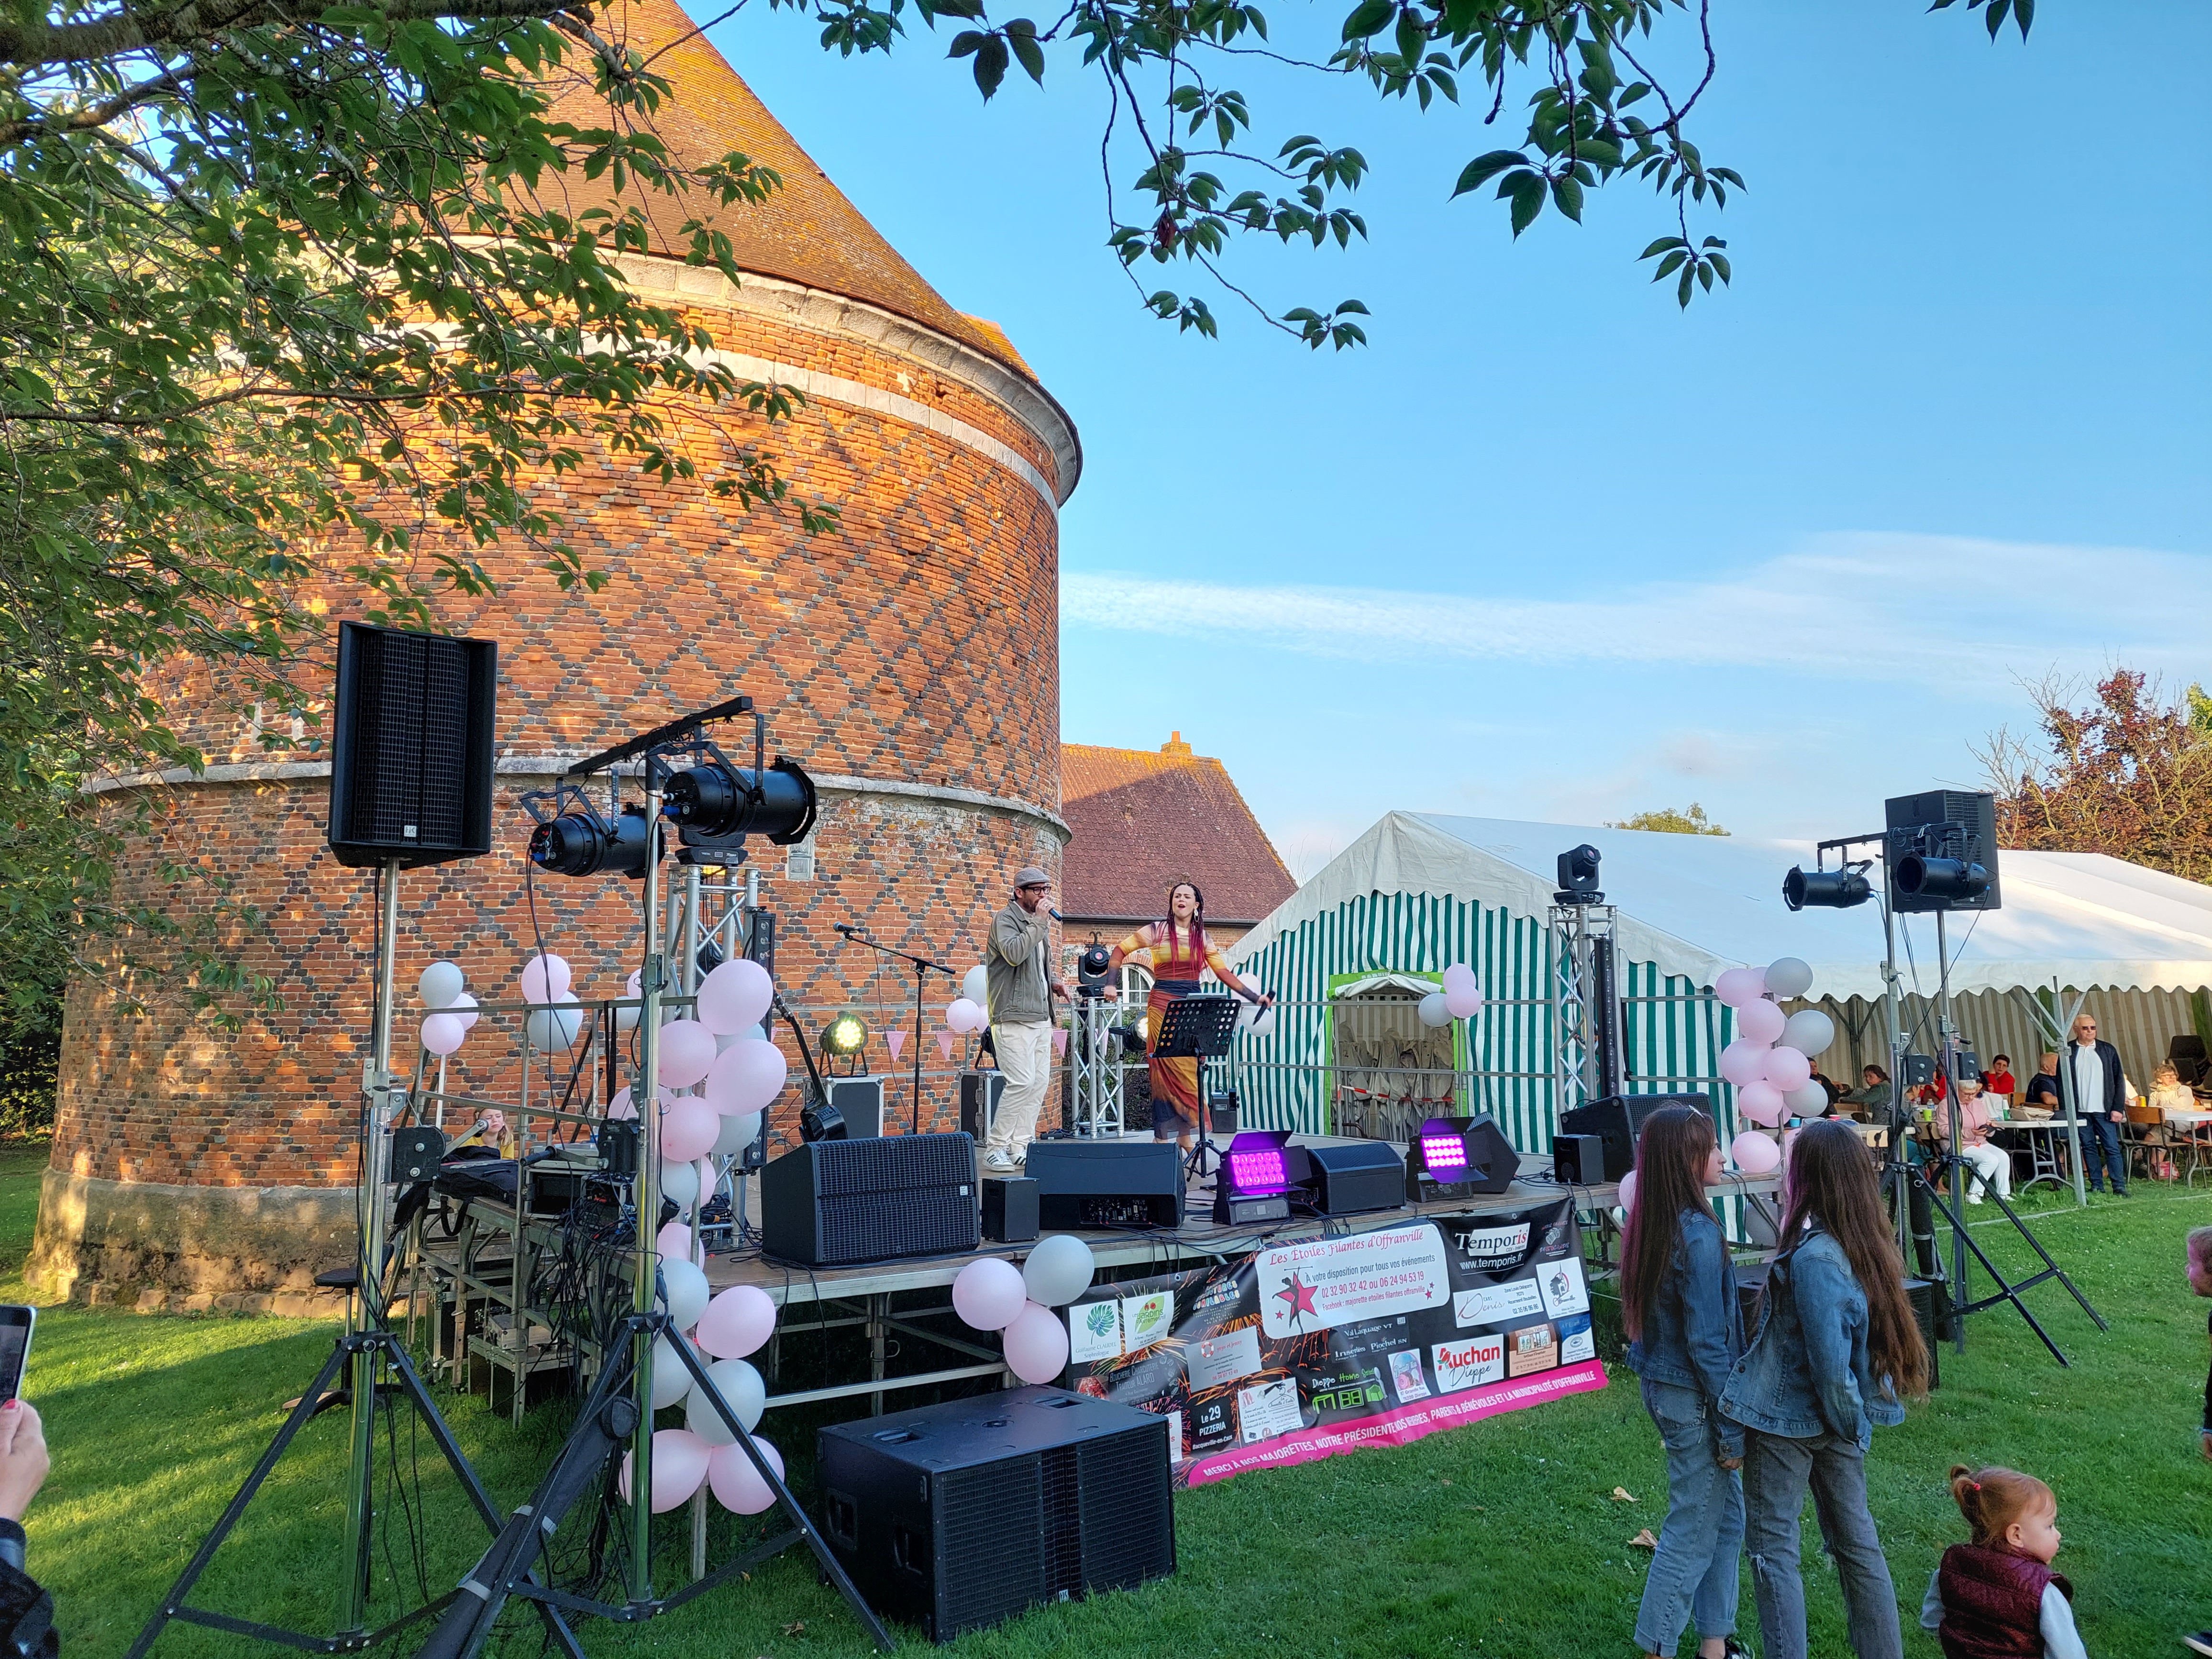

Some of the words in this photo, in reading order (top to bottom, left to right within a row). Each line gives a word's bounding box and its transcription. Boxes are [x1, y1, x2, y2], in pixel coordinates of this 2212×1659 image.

[1270, 1254, 1287, 1265] Les
[1292, 1247, 1325, 1261] Étoiles
[1328, 1239, 1365, 1257] Filantes
[1368, 1228, 1424, 1250] d'Offranville
[1455, 1229, 1528, 1254] Temporis
[1305, 1272, 1311, 1283] À
[1312, 1272, 1326, 1282] votre
[1327, 1266, 1359, 1280] disposition
[1360, 1264, 1374, 1274] pour
[1375, 1261, 1389, 1271] tous
[1390, 1259, 1401, 1268] vos
[1401, 1254, 1436, 1267] événements
[1459, 1252, 1524, 1270] www.temporis.fr
[1322, 1287, 1328, 1298] 02
[1330, 1286, 1338, 1296] 32
[1339, 1283, 1347, 1294] 90
[1349, 1282, 1357, 1293] 32
[1359, 1280, 1368, 1291] 42
[1369, 1281, 1378, 1289] ou
[1380, 1277, 1388, 1287] 06
[1390, 1275, 1398, 1286] 24
[1399, 1273, 1407, 1284] 94
[1409, 1272, 1416, 1283] 53
[1417, 1271, 1424, 1281] 19
[1345, 1295, 1368, 1306] majorette
[1369, 1292, 1384, 1302] etoiles
[1385, 1289, 1403, 1299] filantes
[1404, 1285, 1425, 1296] offranville
[1084, 1350, 1109, 1359] Sophrologue
[1438, 1346, 1500, 1371] Auchan
[1136, 1372, 1155, 1386] ALARD
[1339, 1372, 1360, 1382] Home
[1449, 1364, 1492, 1387] Dieppe
[1201, 1414, 1209, 1424] Le
[1209, 1405, 1221, 1422] 29
[1199, 1422, 1226, 1437] PIZZERIA
[1203, 1463, 1233, 1477] MERCI
[1231, 1460, 1241, 1469] À
[1239, 1456, 1261, 1466] NOS
[1259, 1441, 1317, 1461] MAJORETTES,
[1315, 1434, 1344, 1449] NOTRE
[1455, 1404, 1461, 1415] &
[1460, 1395, 1497, 1413] BÉNÉVOLES
[1495, 1393, 1505, 1403] ET
[1504, 1391, 1515, 1401] LA
[1511, 1379, 1554, 1398] MUNICIPALITÉ
